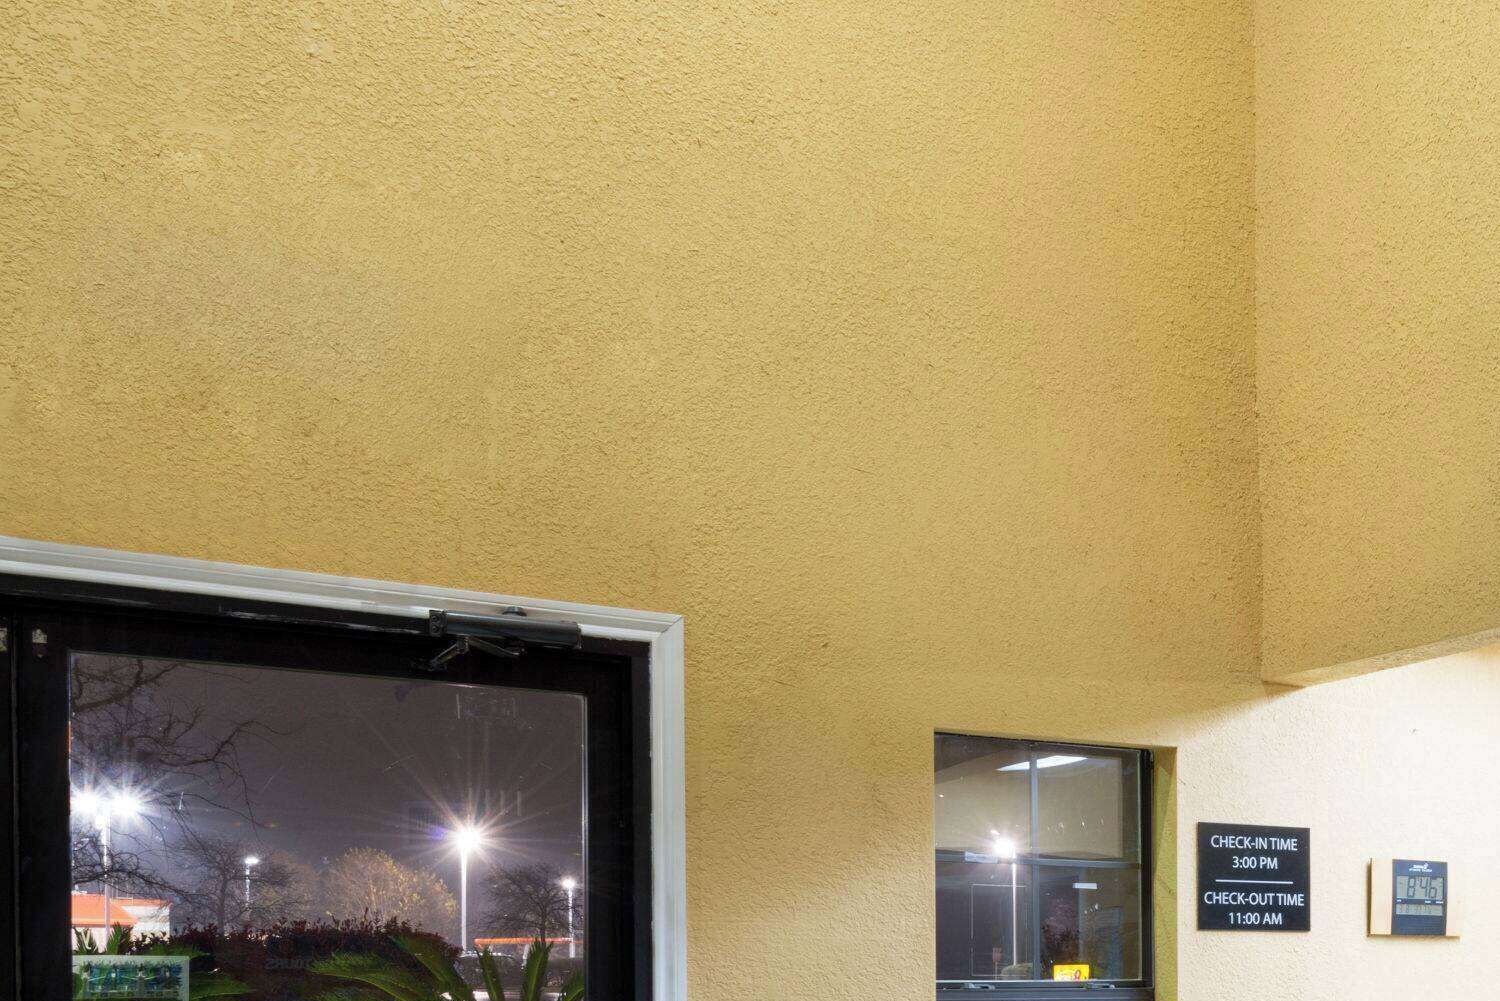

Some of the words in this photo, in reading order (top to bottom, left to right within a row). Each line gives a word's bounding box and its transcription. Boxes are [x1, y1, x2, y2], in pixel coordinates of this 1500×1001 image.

[1211, 835, 1269, 849] CHECK-IN
[1270, 837, 1298, 851] TIME
[1232, 857, 1257, 869] 3:00
[1260, 857, 1277, 869] PM
[1204, 892, 1275, 905] CHECK-OUT
[1277, 893, 1304, 906] TIME
[1229, 913, 1260, 924] 11:00
[1263, 913, 1282, 925] AM
